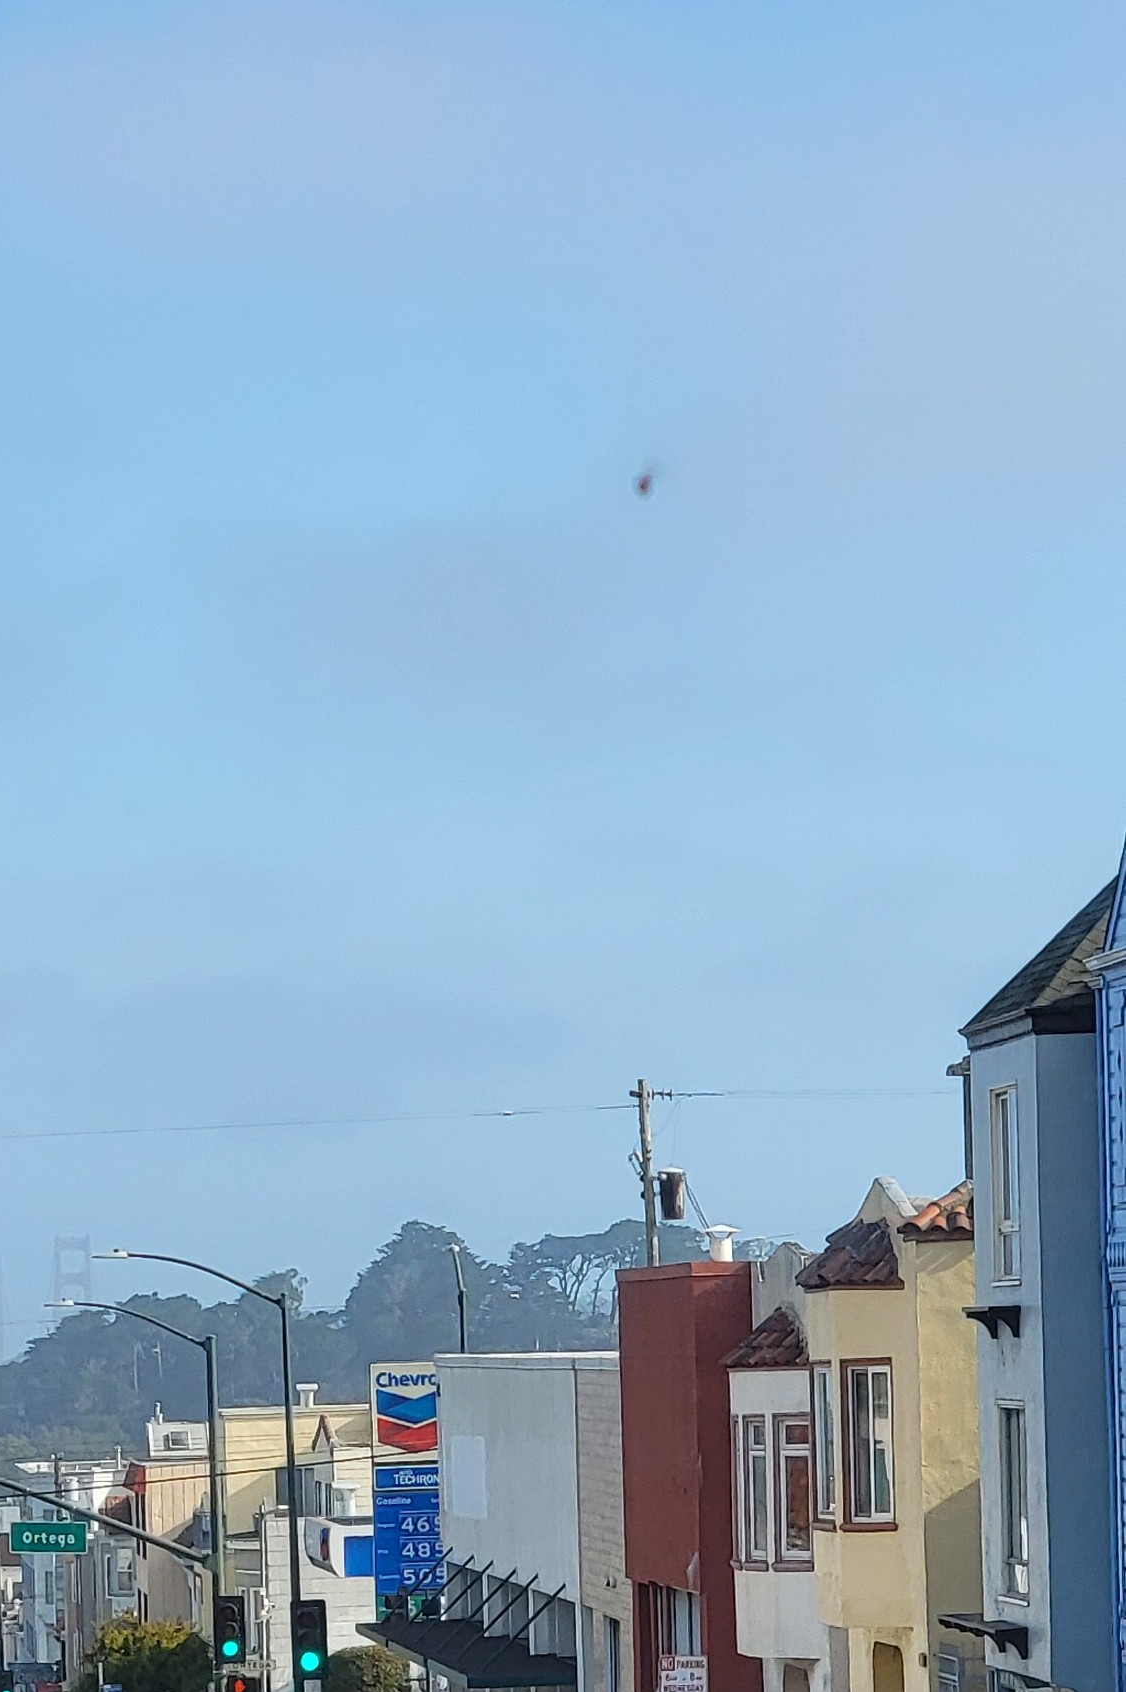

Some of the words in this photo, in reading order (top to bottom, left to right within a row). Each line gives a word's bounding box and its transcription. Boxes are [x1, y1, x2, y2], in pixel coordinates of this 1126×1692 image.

[376, 1372, 436, 1387] Chevro
[23, 1531, 75, 1548] Ortega
[661, 1657, 674, 1670] NO
